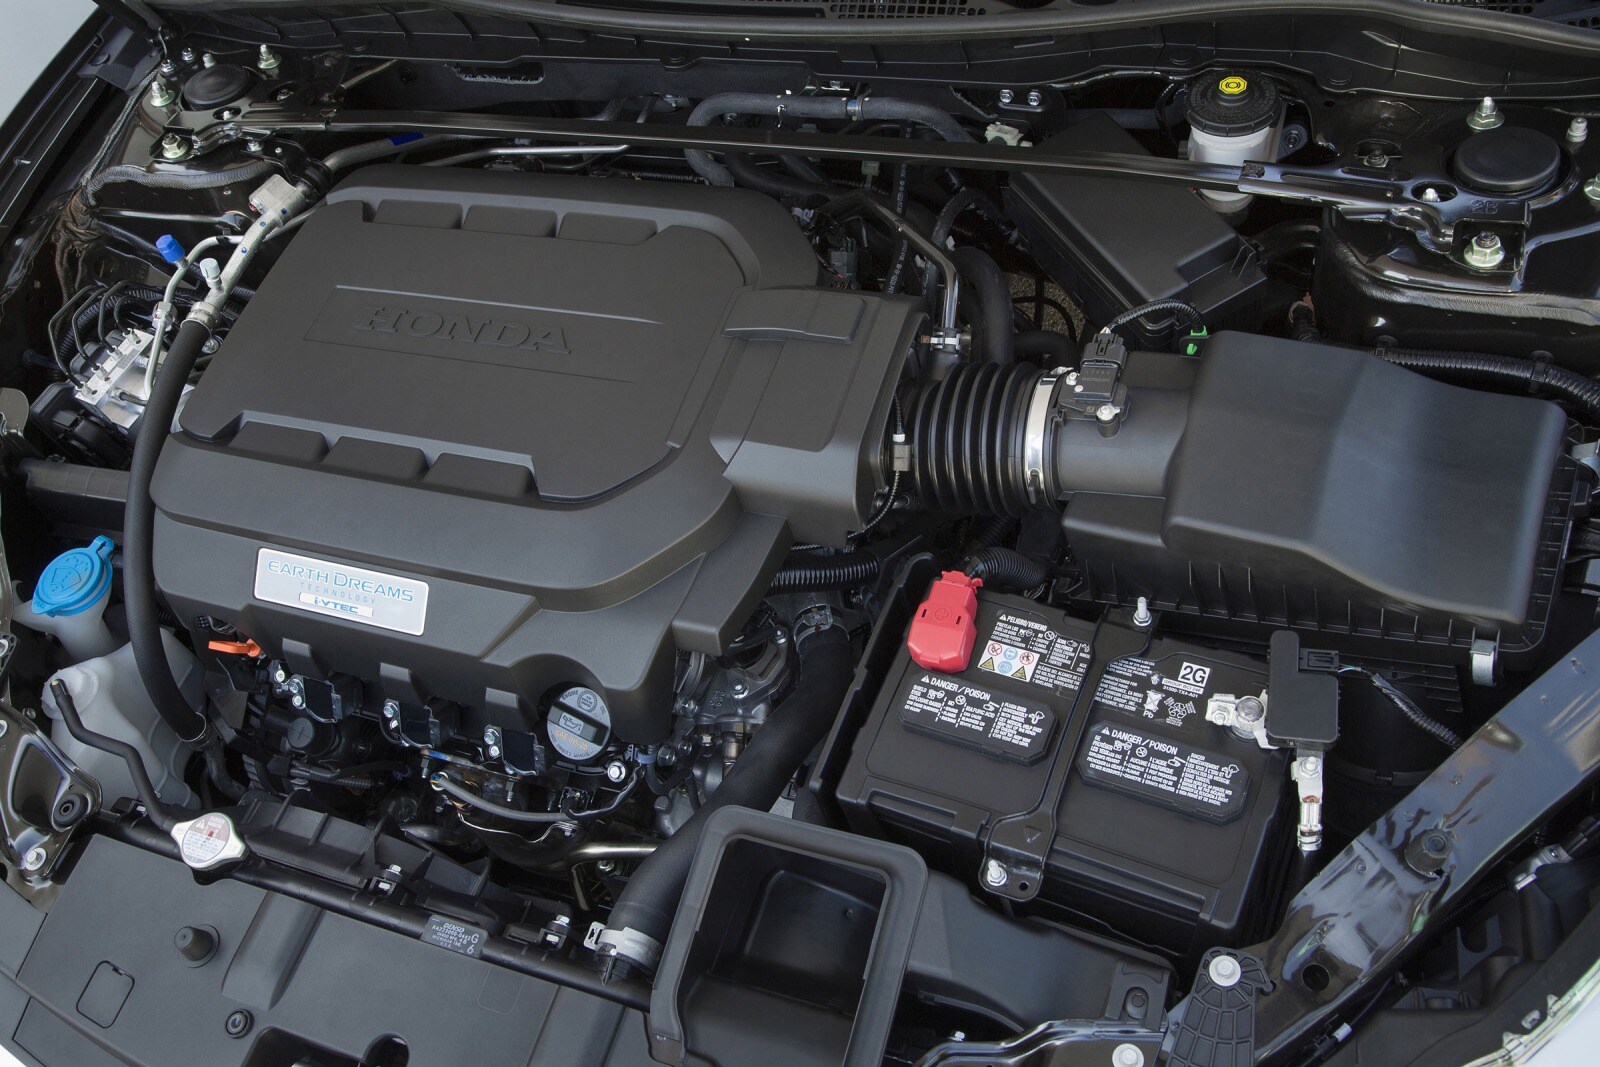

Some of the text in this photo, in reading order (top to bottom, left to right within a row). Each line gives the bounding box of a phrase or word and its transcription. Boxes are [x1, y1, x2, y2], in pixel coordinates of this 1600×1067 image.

[355, 307, 571, 354] HONDA
[268, 560, 414, 602] EARTH DREAMS
[300, 582, 375, 604] TECHNOLOGY
[1181, 665, 1207, 685] 2G
[562, 690, 578, 700] ENGINE
[966, 706, 985, 715] SULFURIC
[1143, 709, 1154, 719] Pb
[555, 729, 568, 739] SAE
[443, 923, 465, 933] DENSO
[471, 934, 479, 944] G
[467, 944, 474, 954] 6
